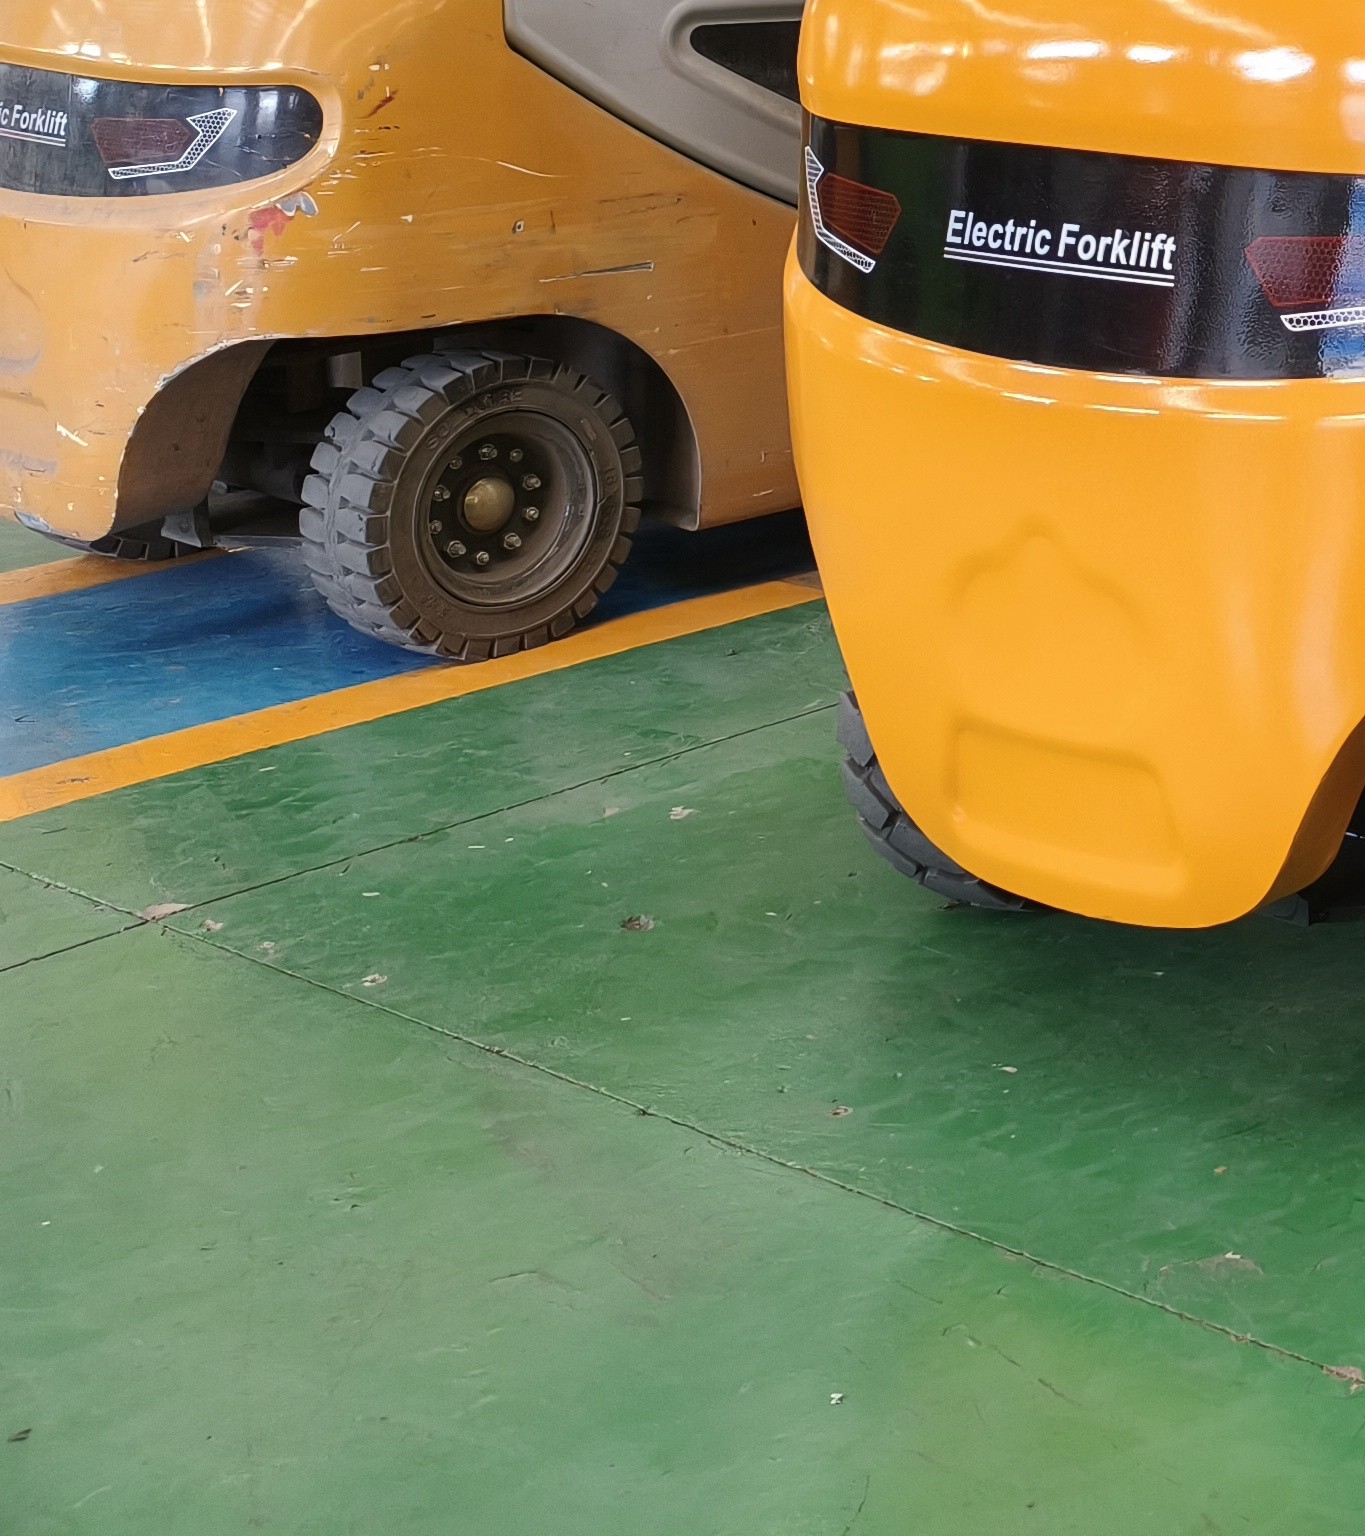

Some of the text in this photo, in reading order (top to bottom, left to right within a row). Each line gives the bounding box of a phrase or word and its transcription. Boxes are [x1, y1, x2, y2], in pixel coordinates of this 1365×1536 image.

[11, 104, 68, 136] Forklift
[946, 209, 1177, 271] Electric Forklift
